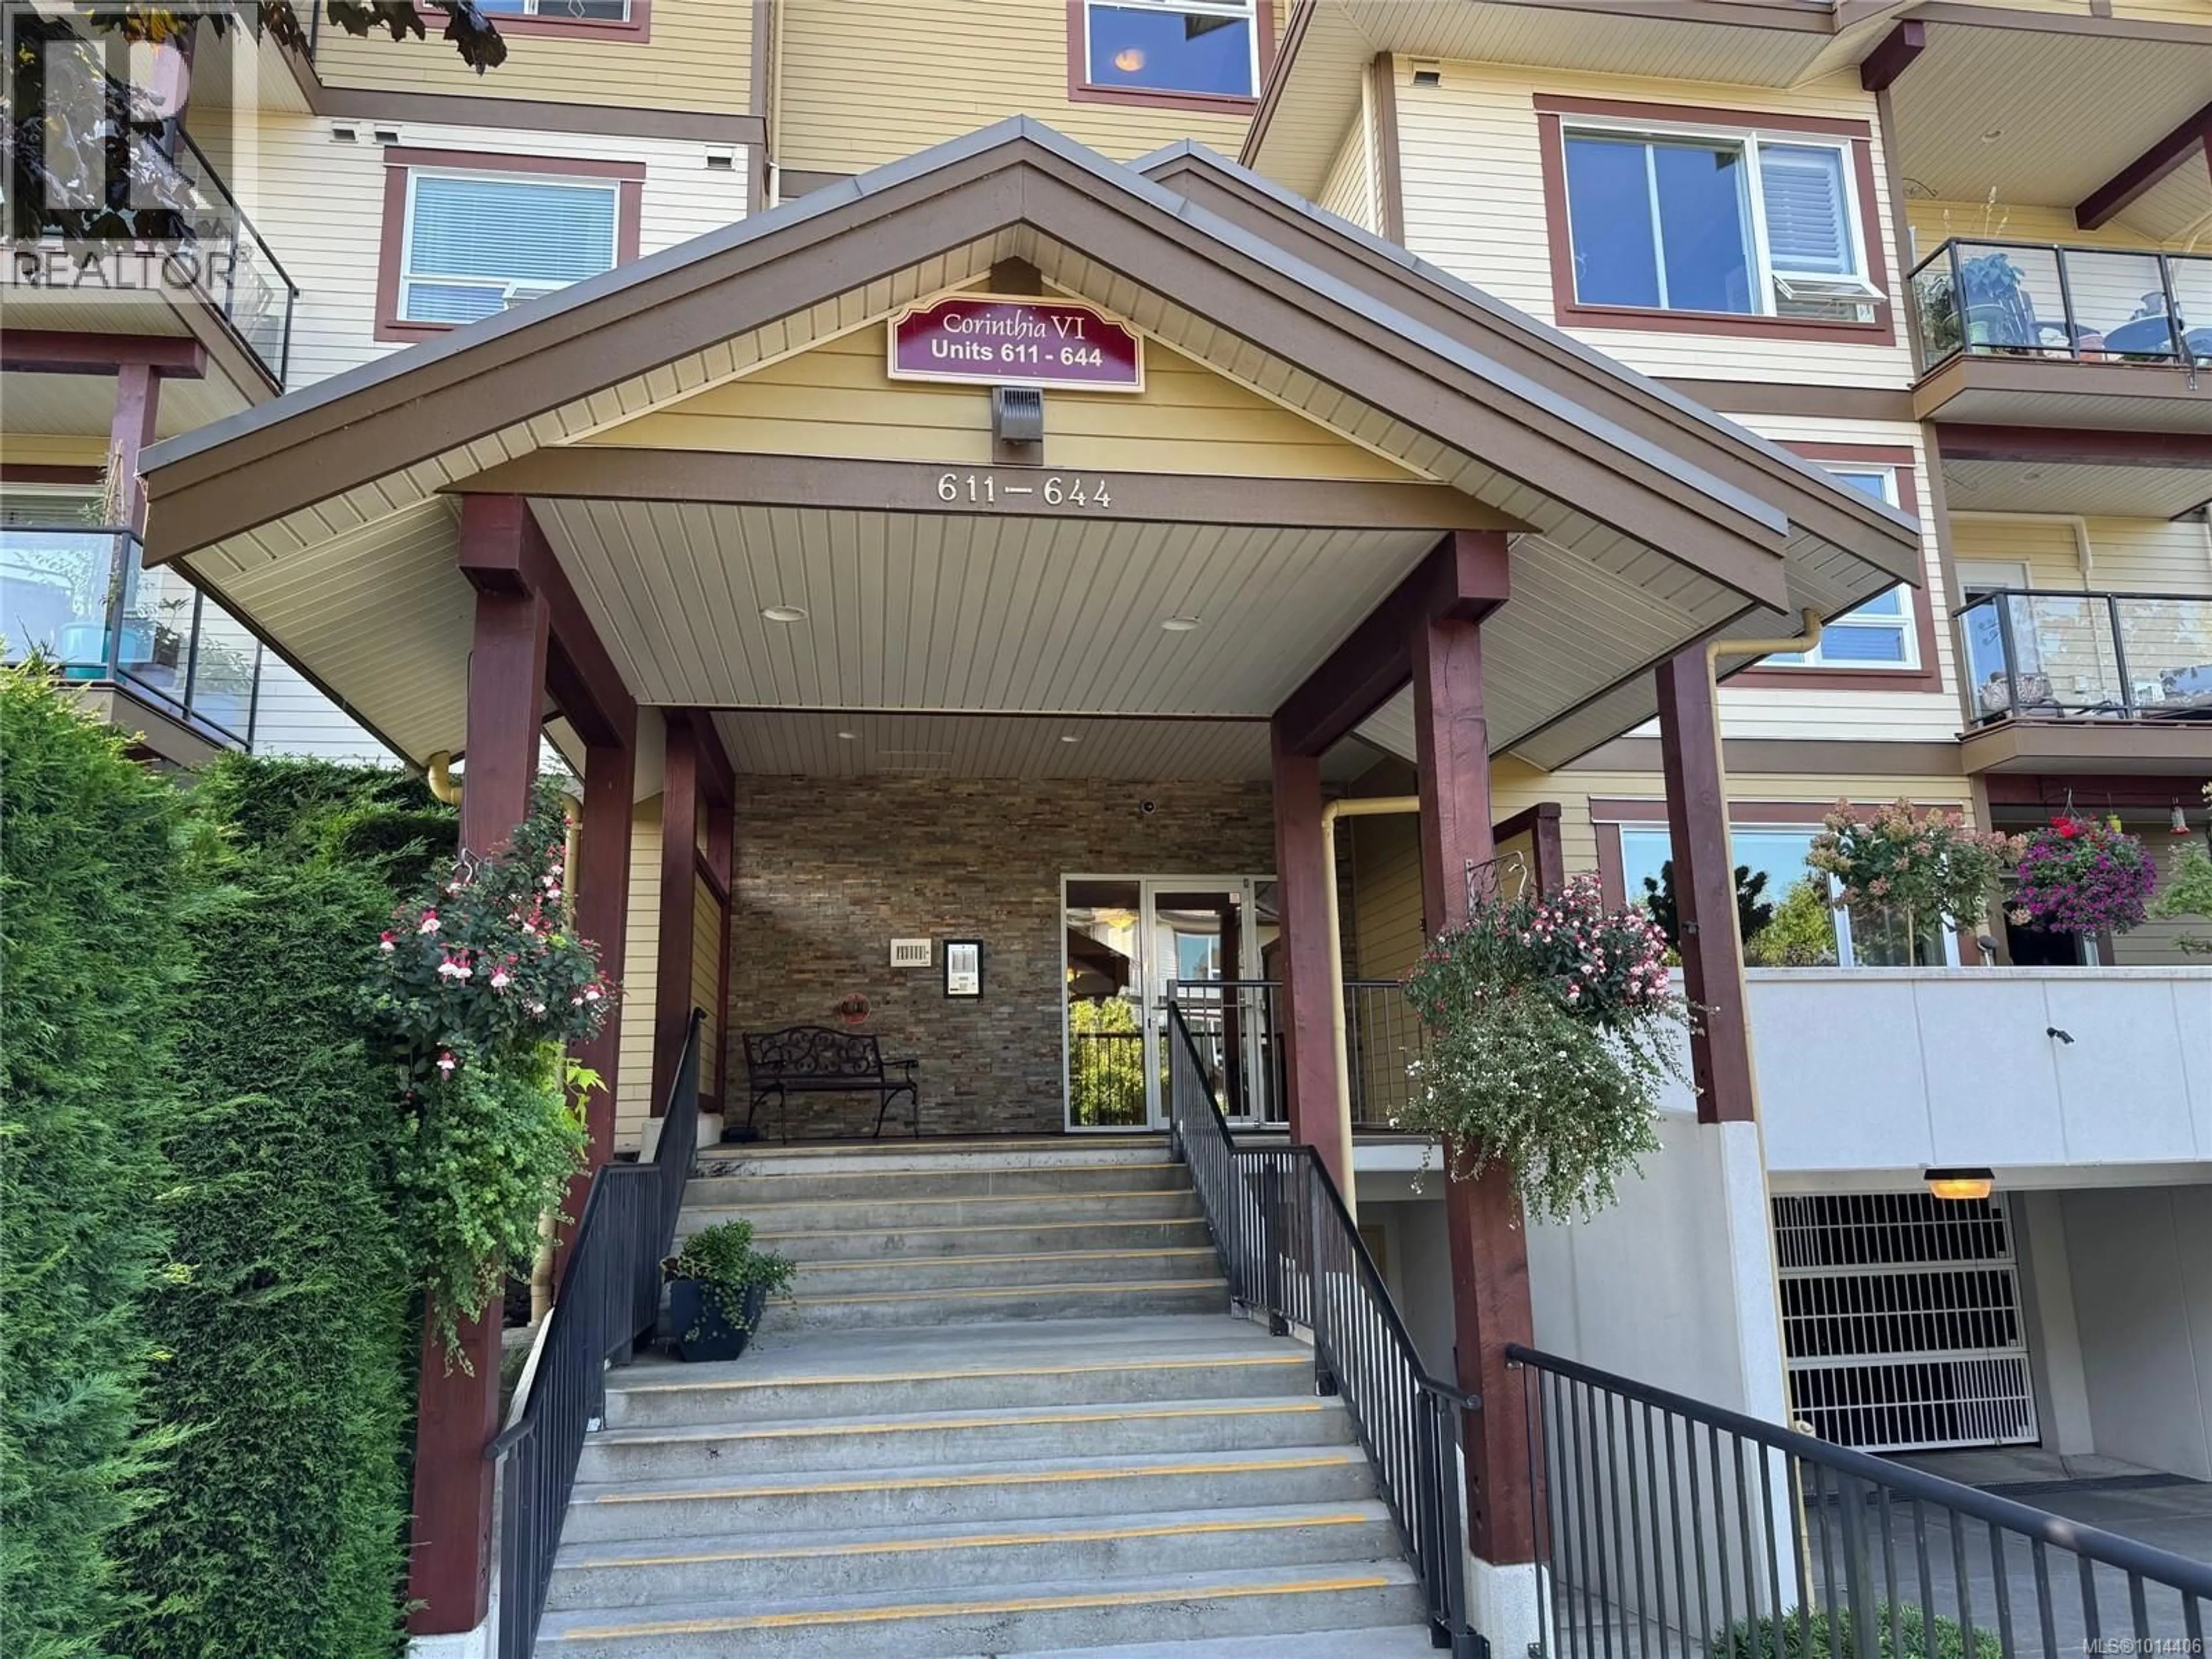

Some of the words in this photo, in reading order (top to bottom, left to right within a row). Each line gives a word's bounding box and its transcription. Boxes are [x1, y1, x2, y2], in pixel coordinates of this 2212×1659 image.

[943, 309, 1046, 340] Corinthia
[1050, 315, 1085, 340] VI
[931, 339, 993, 360] Units
[1001, 343, 1037, 363] 611
[1060, 347, 1103, 366] 644
